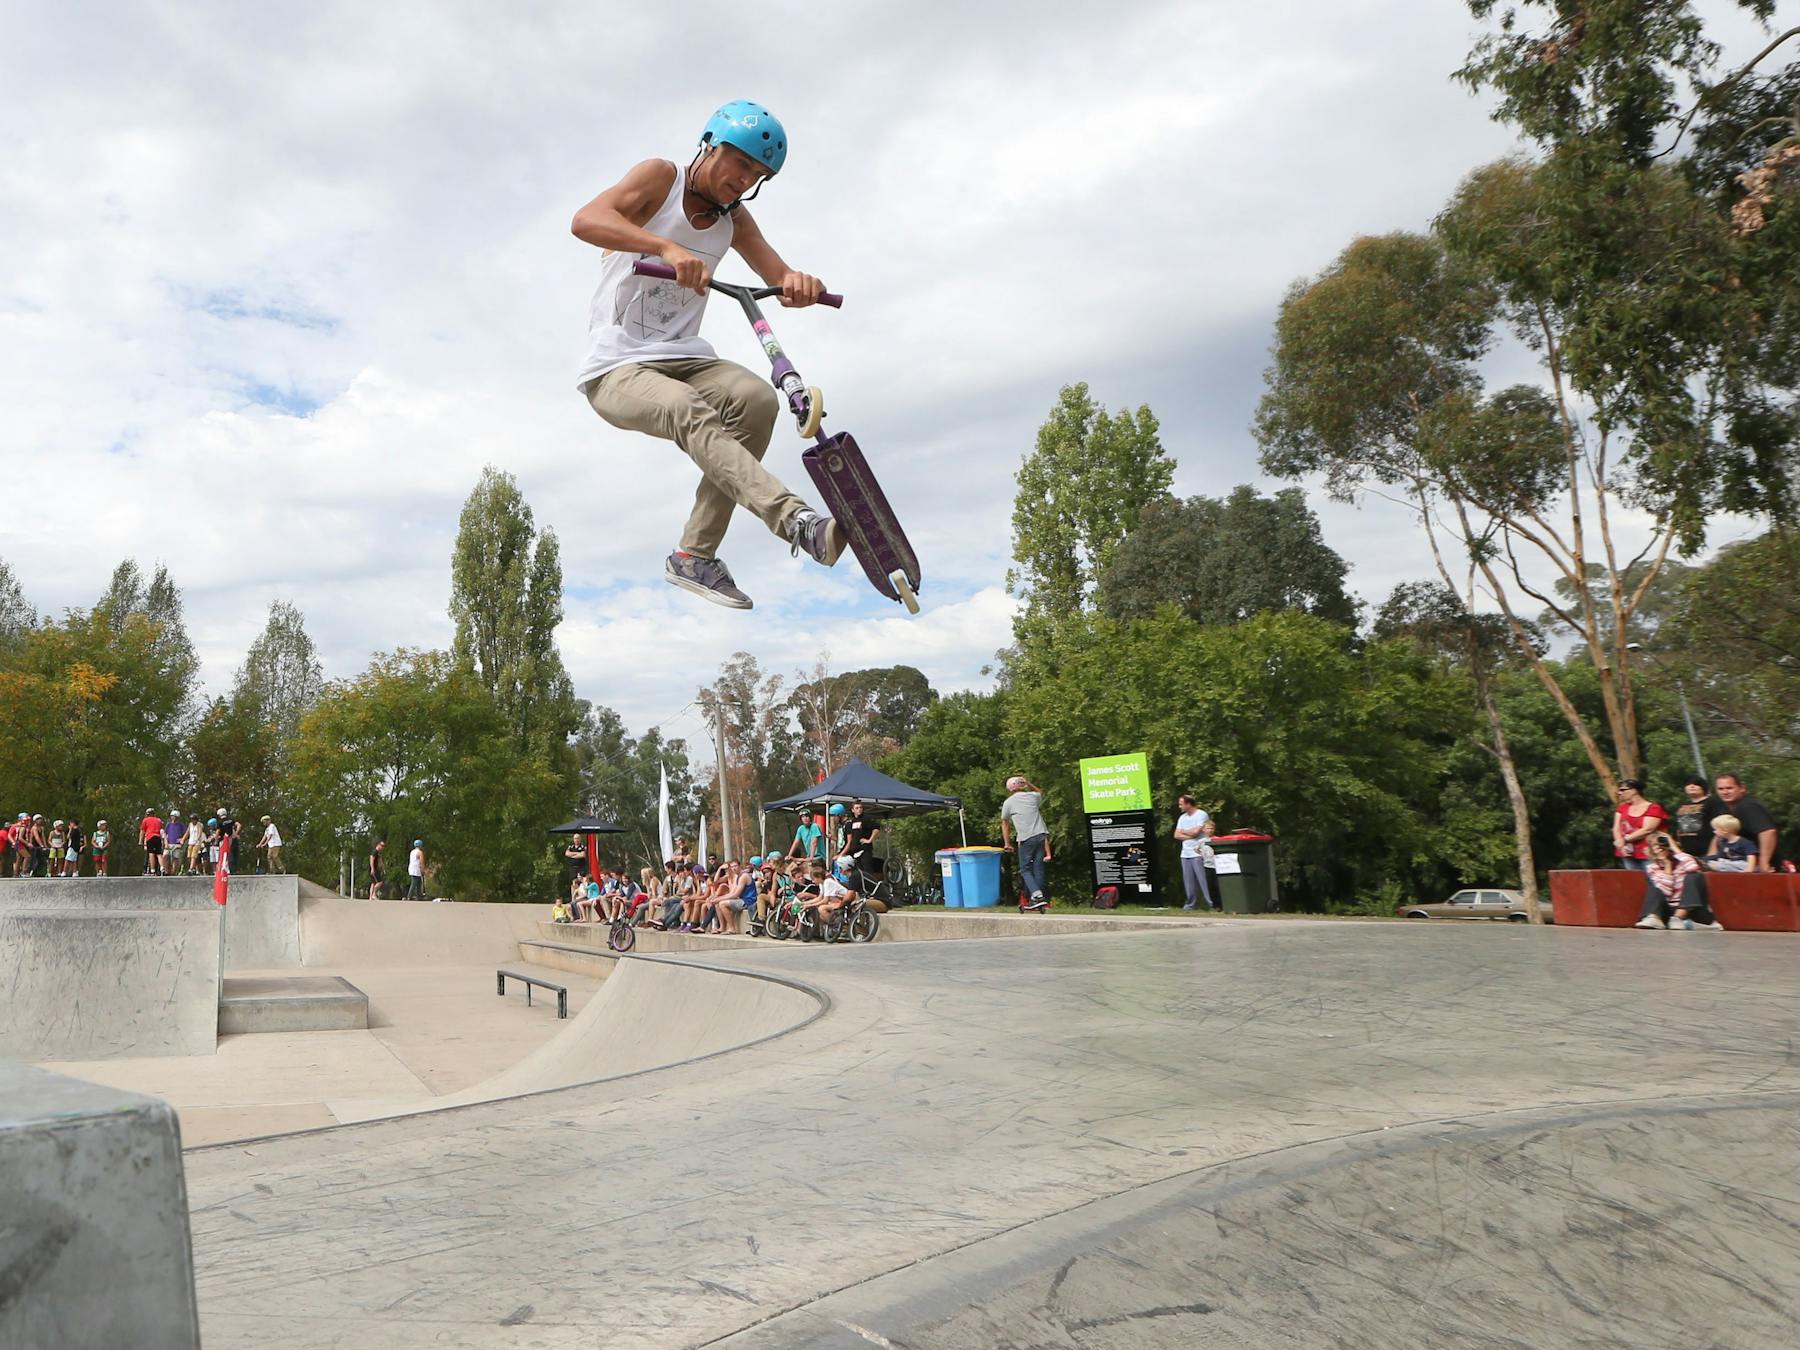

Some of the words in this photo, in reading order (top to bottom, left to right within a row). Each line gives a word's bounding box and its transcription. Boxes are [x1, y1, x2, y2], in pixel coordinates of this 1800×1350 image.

[1087, 767, 1113, 775] James
[1114, 763, 1139, 772] Scott
[1088, 776, 1128, 787] Memorial
[1089, 789, 1114, 799] Skate
[1114, 787, 1136, 796] Park
